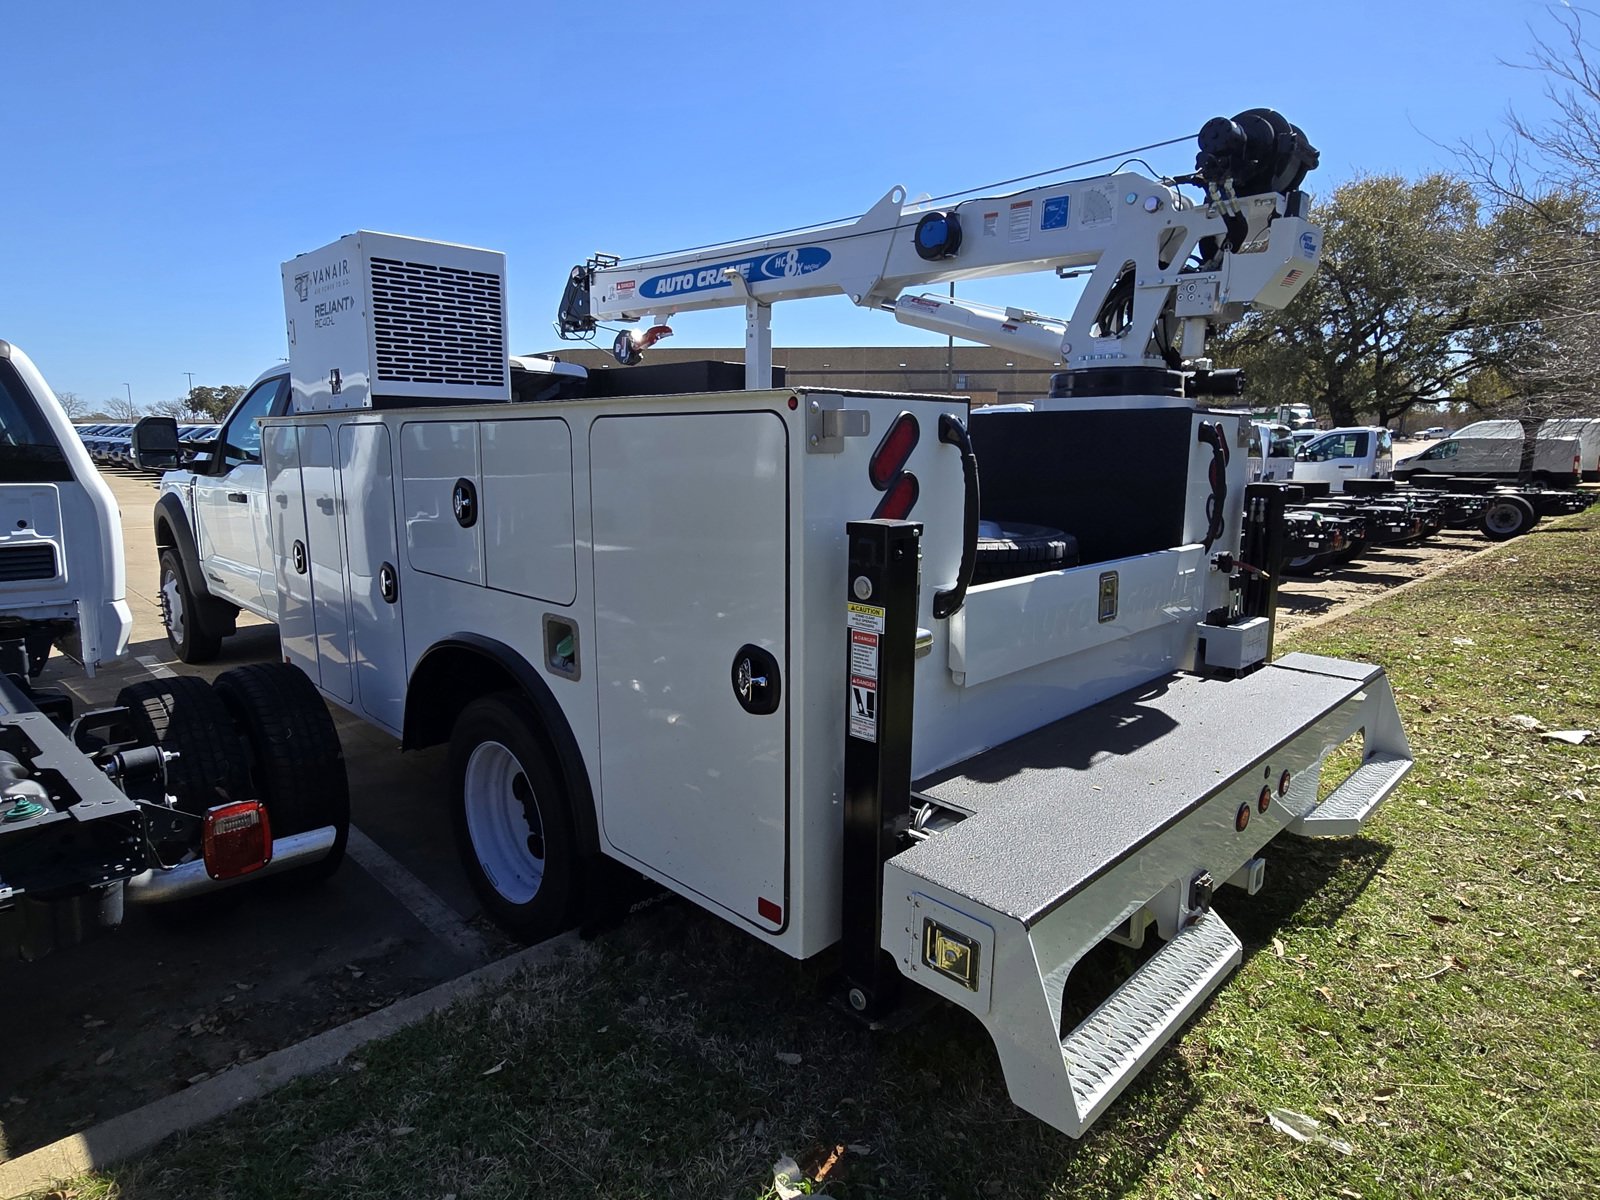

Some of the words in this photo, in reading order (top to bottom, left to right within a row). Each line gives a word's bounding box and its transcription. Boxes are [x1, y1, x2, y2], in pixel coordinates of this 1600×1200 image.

[312, 259, 349, 285] VANAIR
[655, 273, 694, 295] AUTO
[314, 296, 350, 319] RELIANT
[855, 605, 881, 616] CAUTION
[858, 635, 876, 643] DANGER
[856, 678, 876, 689] DANGER
